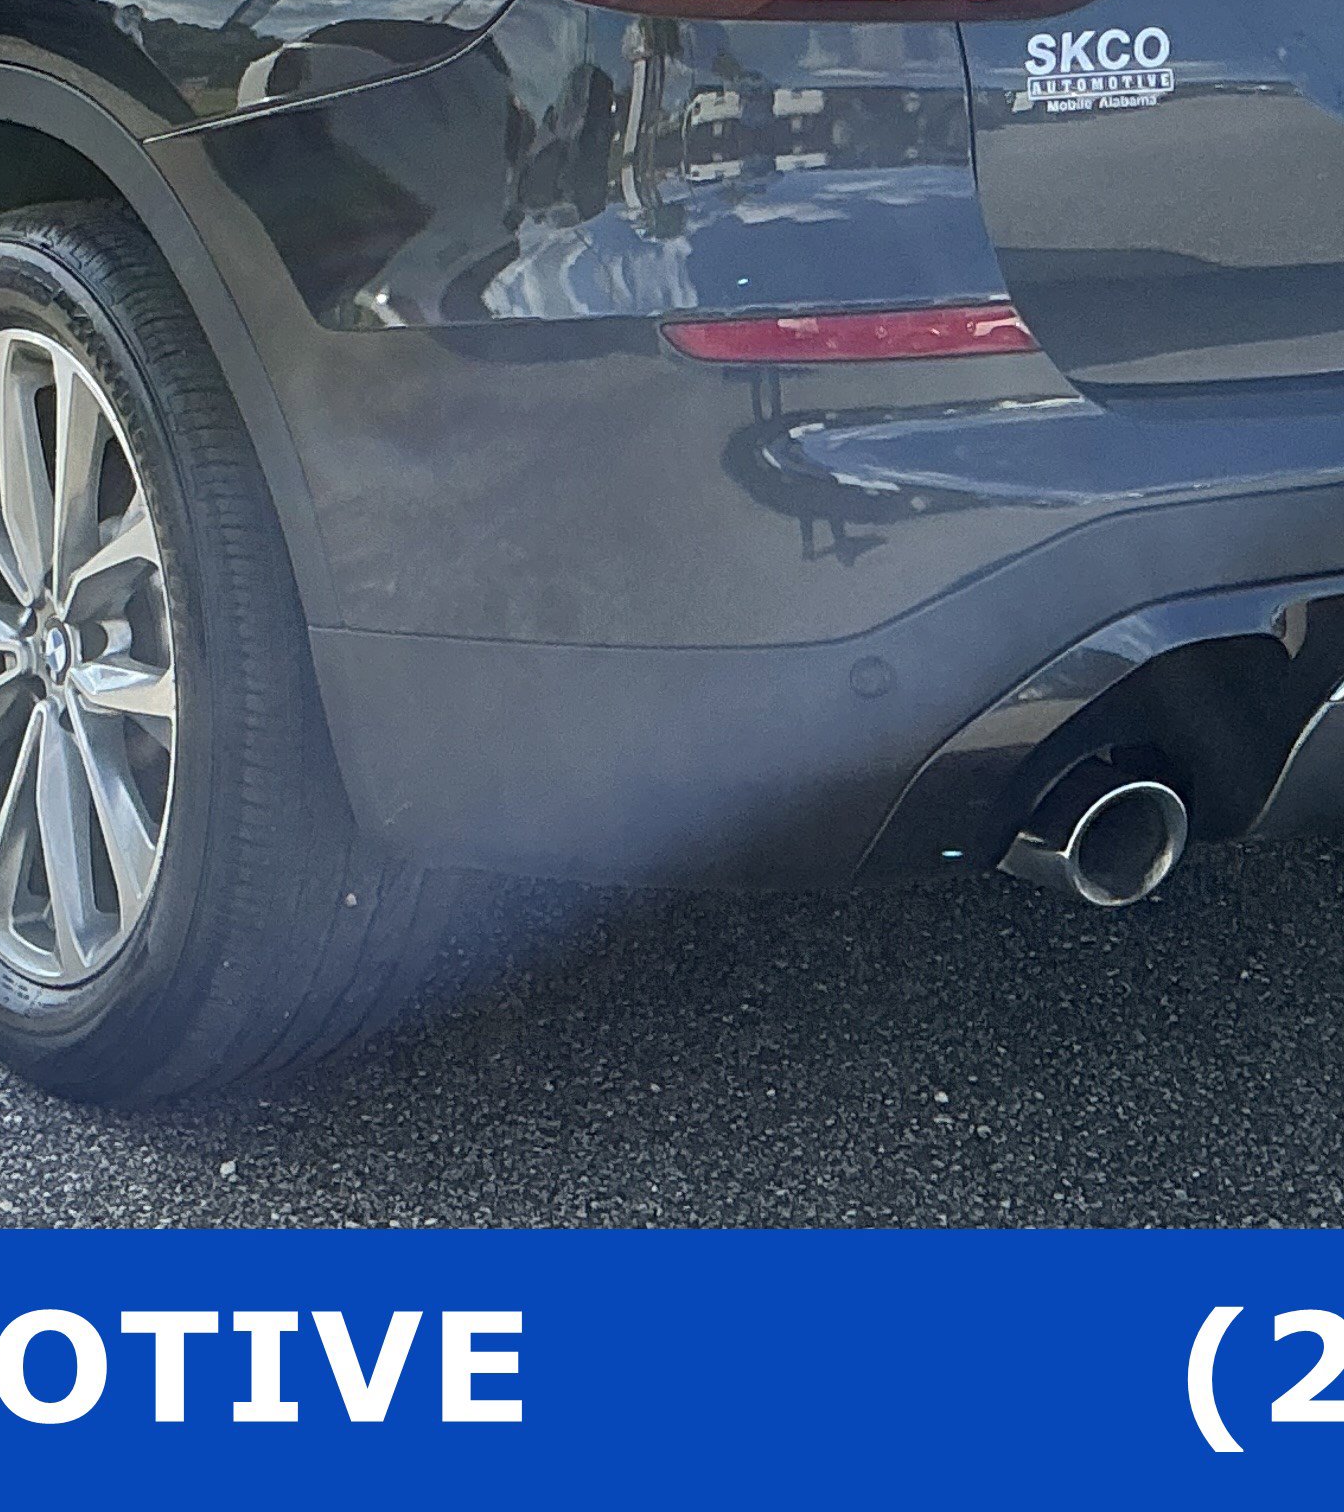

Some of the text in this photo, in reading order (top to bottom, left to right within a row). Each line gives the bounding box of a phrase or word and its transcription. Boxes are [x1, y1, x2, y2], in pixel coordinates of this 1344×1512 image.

[1025, 26, 1171, 76] SKCO
[1032, 73, 1170, 95] AUTOMOTIVE
[1047, 94, 1158, 113] Mobile Alabama
